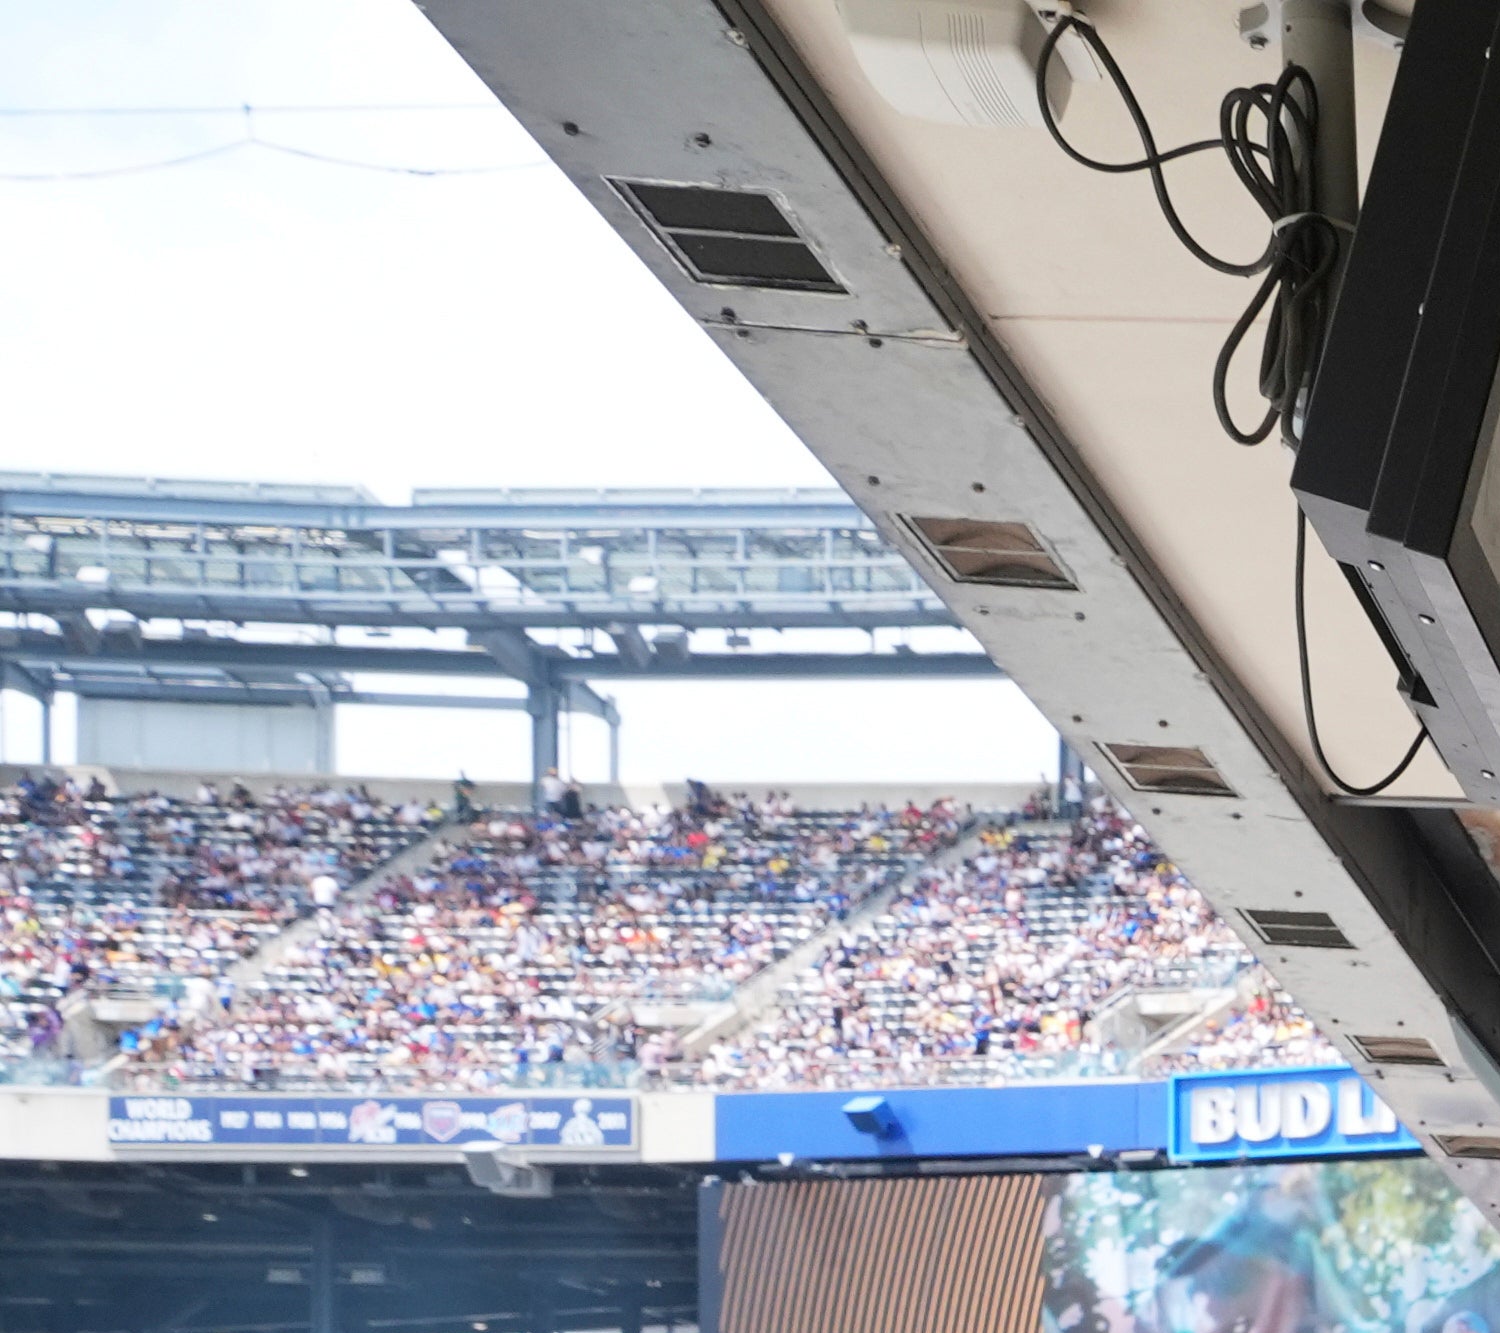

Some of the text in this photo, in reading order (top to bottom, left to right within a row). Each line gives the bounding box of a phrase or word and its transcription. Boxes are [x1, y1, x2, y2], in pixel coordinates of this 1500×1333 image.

[125, 1098, 192, 1120] WORLD
[1190, 1081, 1332, 1144] BUD
[108, 1118, 213, 1141] CHAMPIONS
